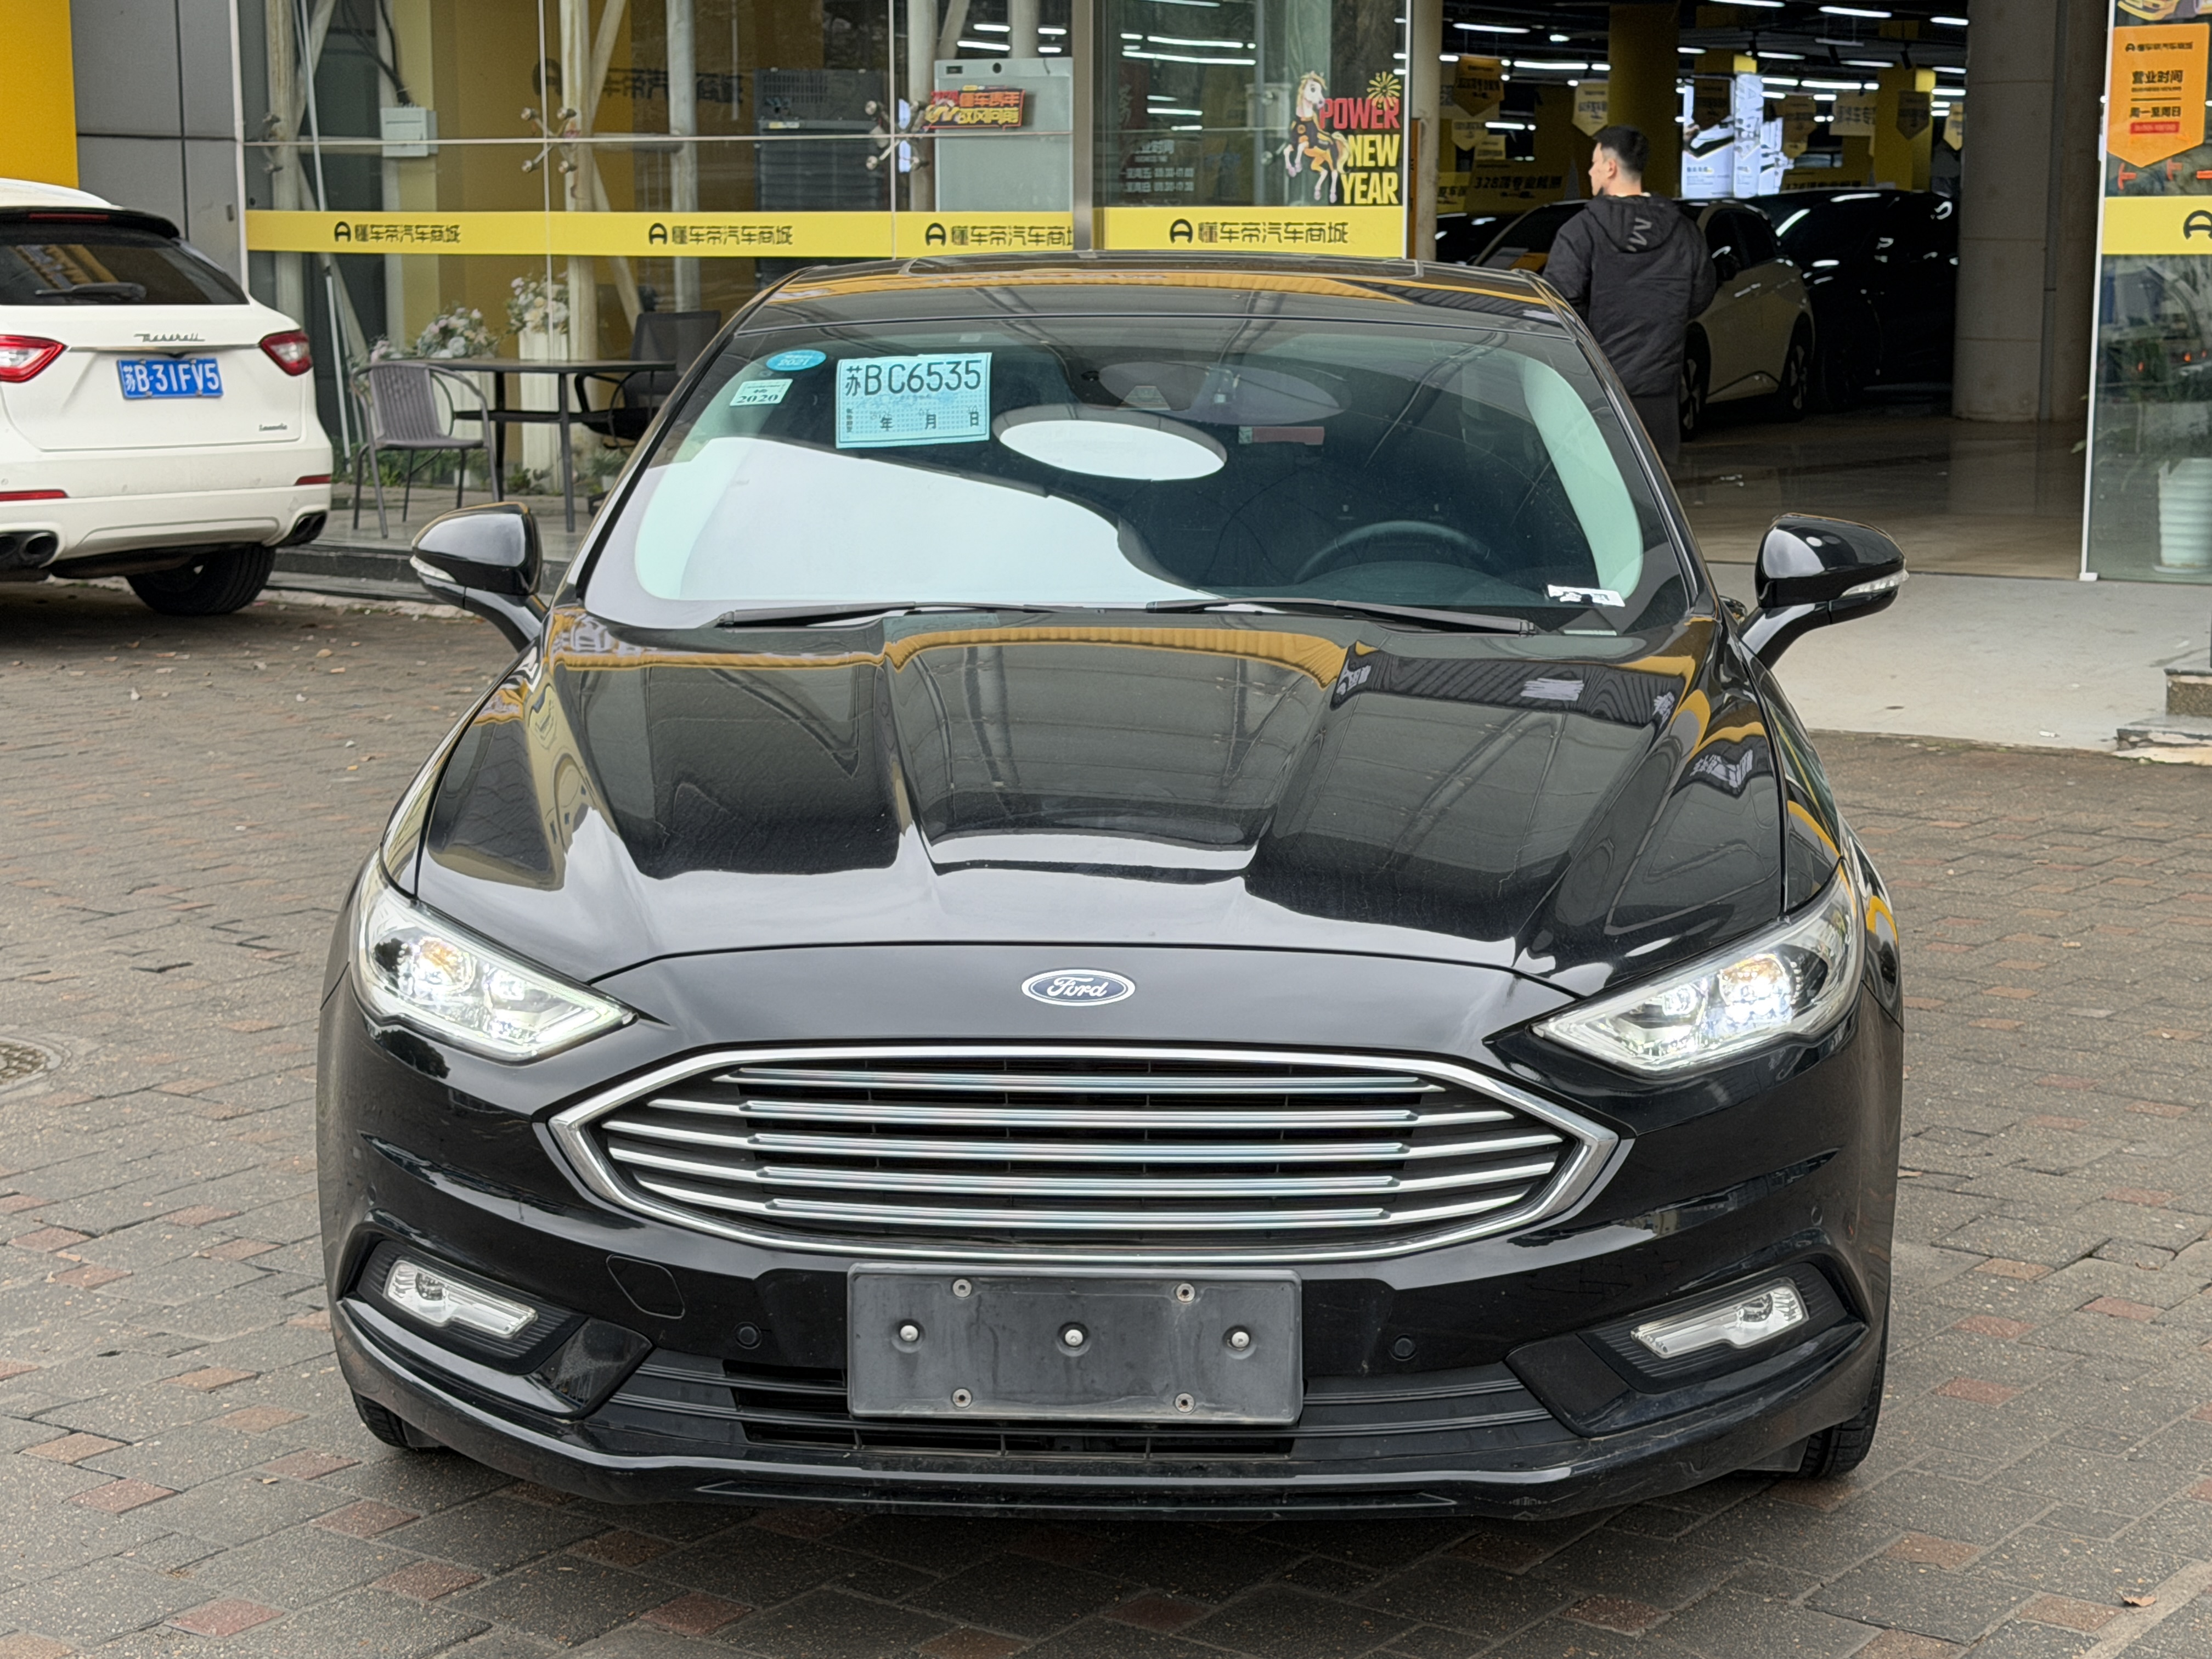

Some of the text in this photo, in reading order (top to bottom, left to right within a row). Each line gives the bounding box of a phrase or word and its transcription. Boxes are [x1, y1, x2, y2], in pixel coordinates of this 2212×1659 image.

[1319, 97, 1401, 129] POWER
[1347, 134, 1401, 167] NEW
[1340, 172, 1399, 205] YEAR
[1198, 221, 1348, 244] 懂车帝汽车商城
[736, 394, 779, 403] 2020
[879, 411, 979, 431] 年 月 日
[1046, 977, 1109, 997] Ford
